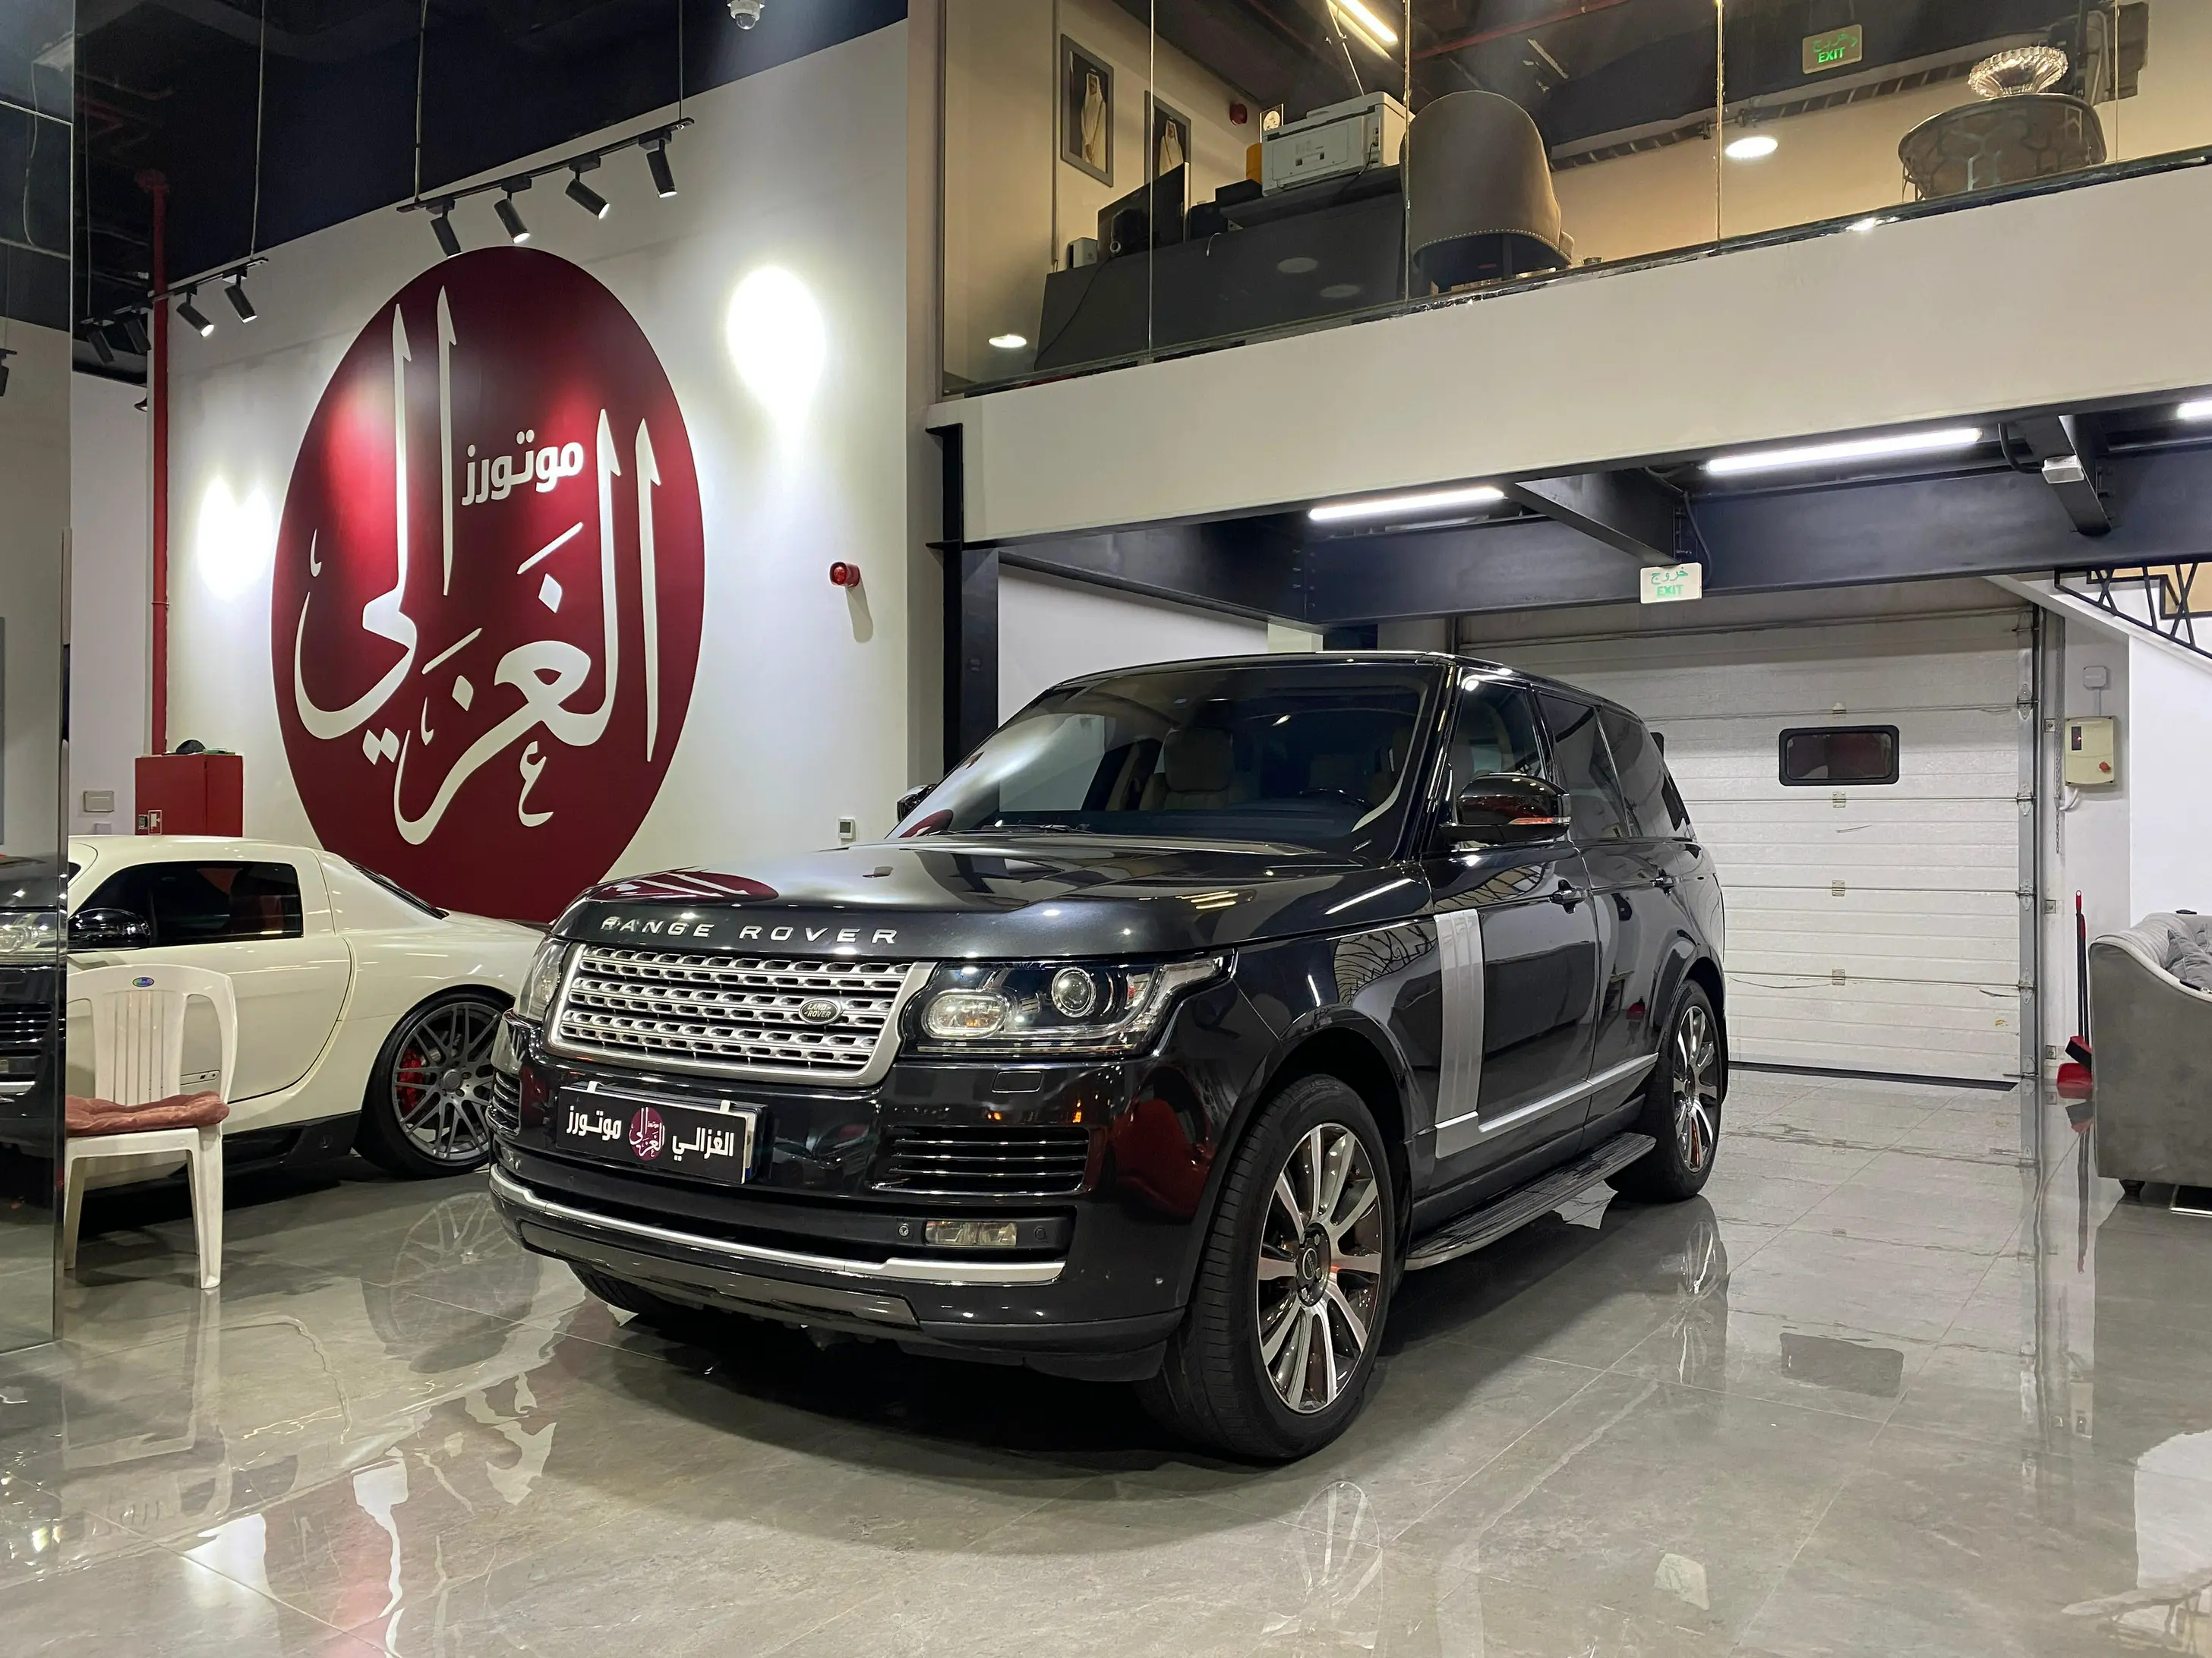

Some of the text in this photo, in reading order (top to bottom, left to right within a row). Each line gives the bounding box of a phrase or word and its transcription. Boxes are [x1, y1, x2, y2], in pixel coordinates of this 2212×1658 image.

[1818, 46, 1846, 63] EXIT
[461, 429, 584, 506] موتورز
[1651, 566, 1689, 585] خروج
[1657, 585, 1683, 597] EXIT
[601, 916, 898, 944] RANGE ROVER
[806, 1010, 831, 1018] ROVER
[566, 1105, 735, 1162] الغزالي موتورز
